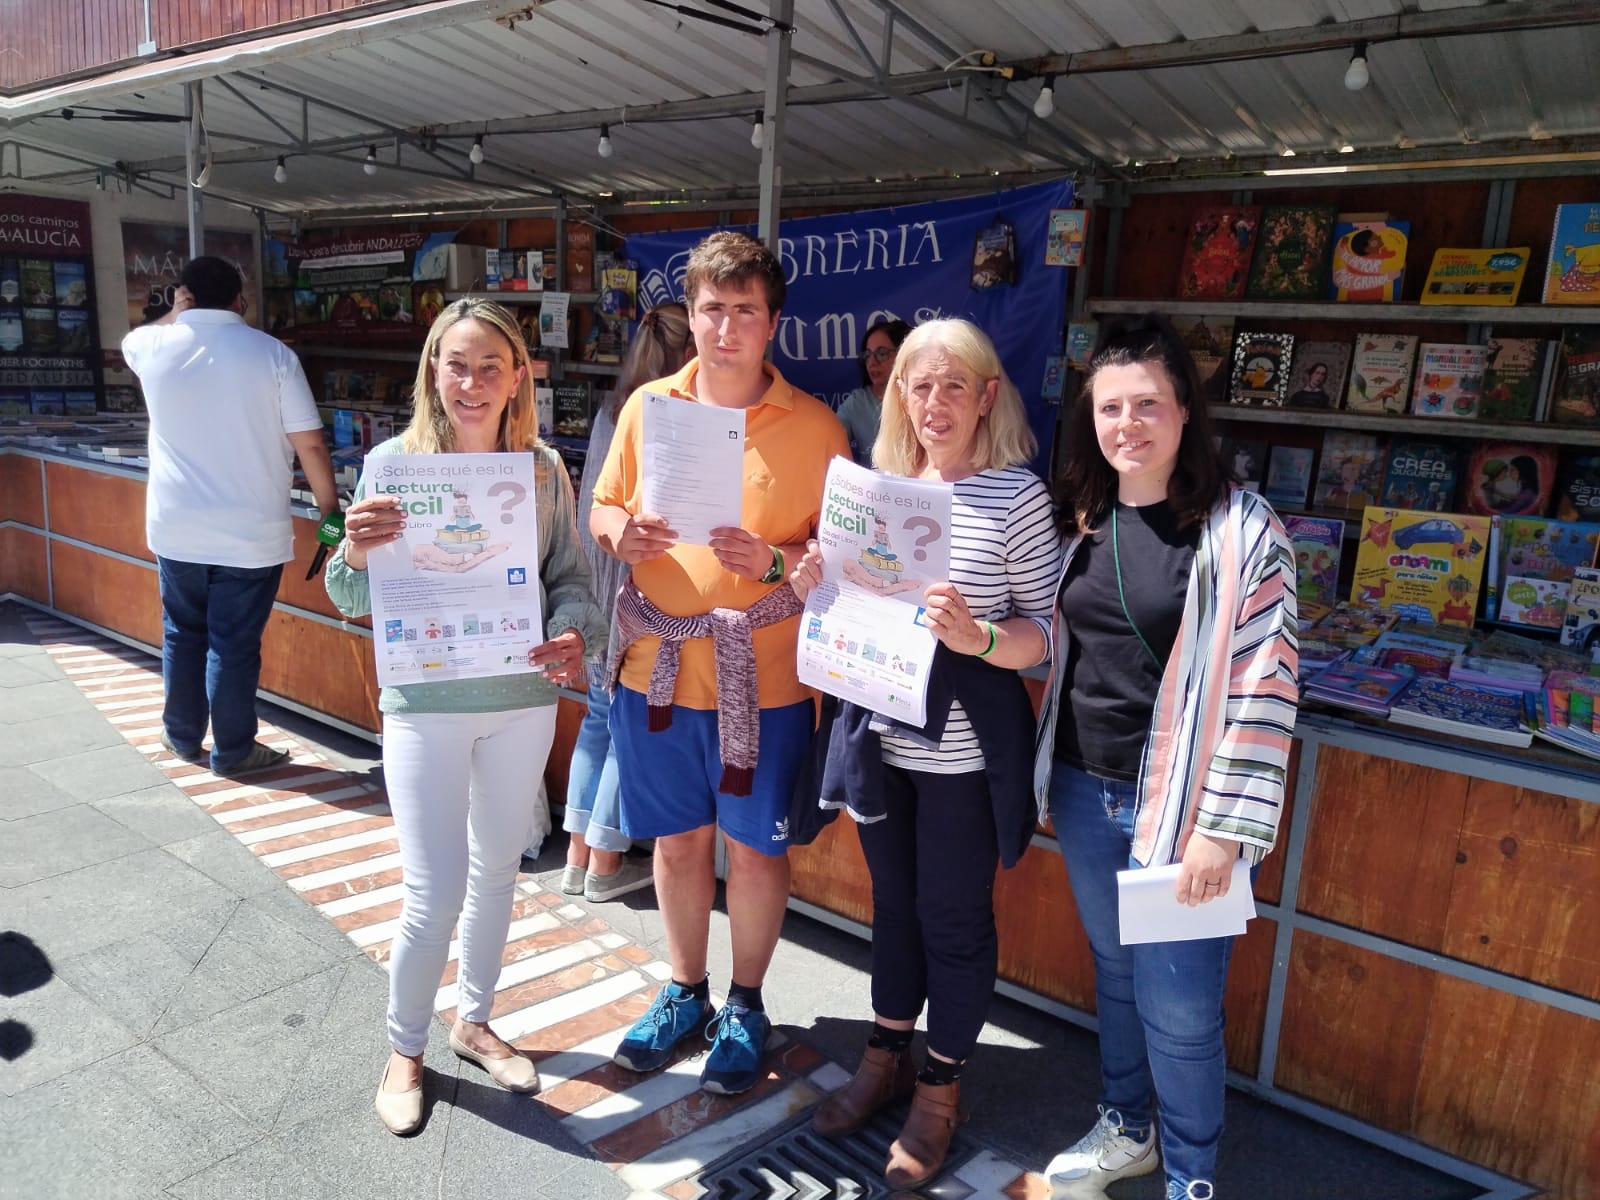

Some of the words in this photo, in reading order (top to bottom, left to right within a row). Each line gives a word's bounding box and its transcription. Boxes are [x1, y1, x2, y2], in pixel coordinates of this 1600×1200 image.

[29, 216, 79, 229] caminos
[778, 220, 943, 285] BRERIA
[374, 465, 436, 479] ¿Sabes
[440, 464, 472, 478] qué
[476, 465, 495, 476] es
[499, 463, 514, 475] la
[1392, 457, 1446, 473] CREA
[375, 482, 454, 494] Lectura
[831, 474, 864, 496] ¿Sabes
[866, 489, 891, 504] qué
[894, 496, 913, 507] es
[917, 496, 931, 511] la
[1570, 484, 1600, 495] SIST
[828, 488, 875, 517] Lectura
[408, 521, 433, 529] Libro
[826, 504, 867, 536] fácil
